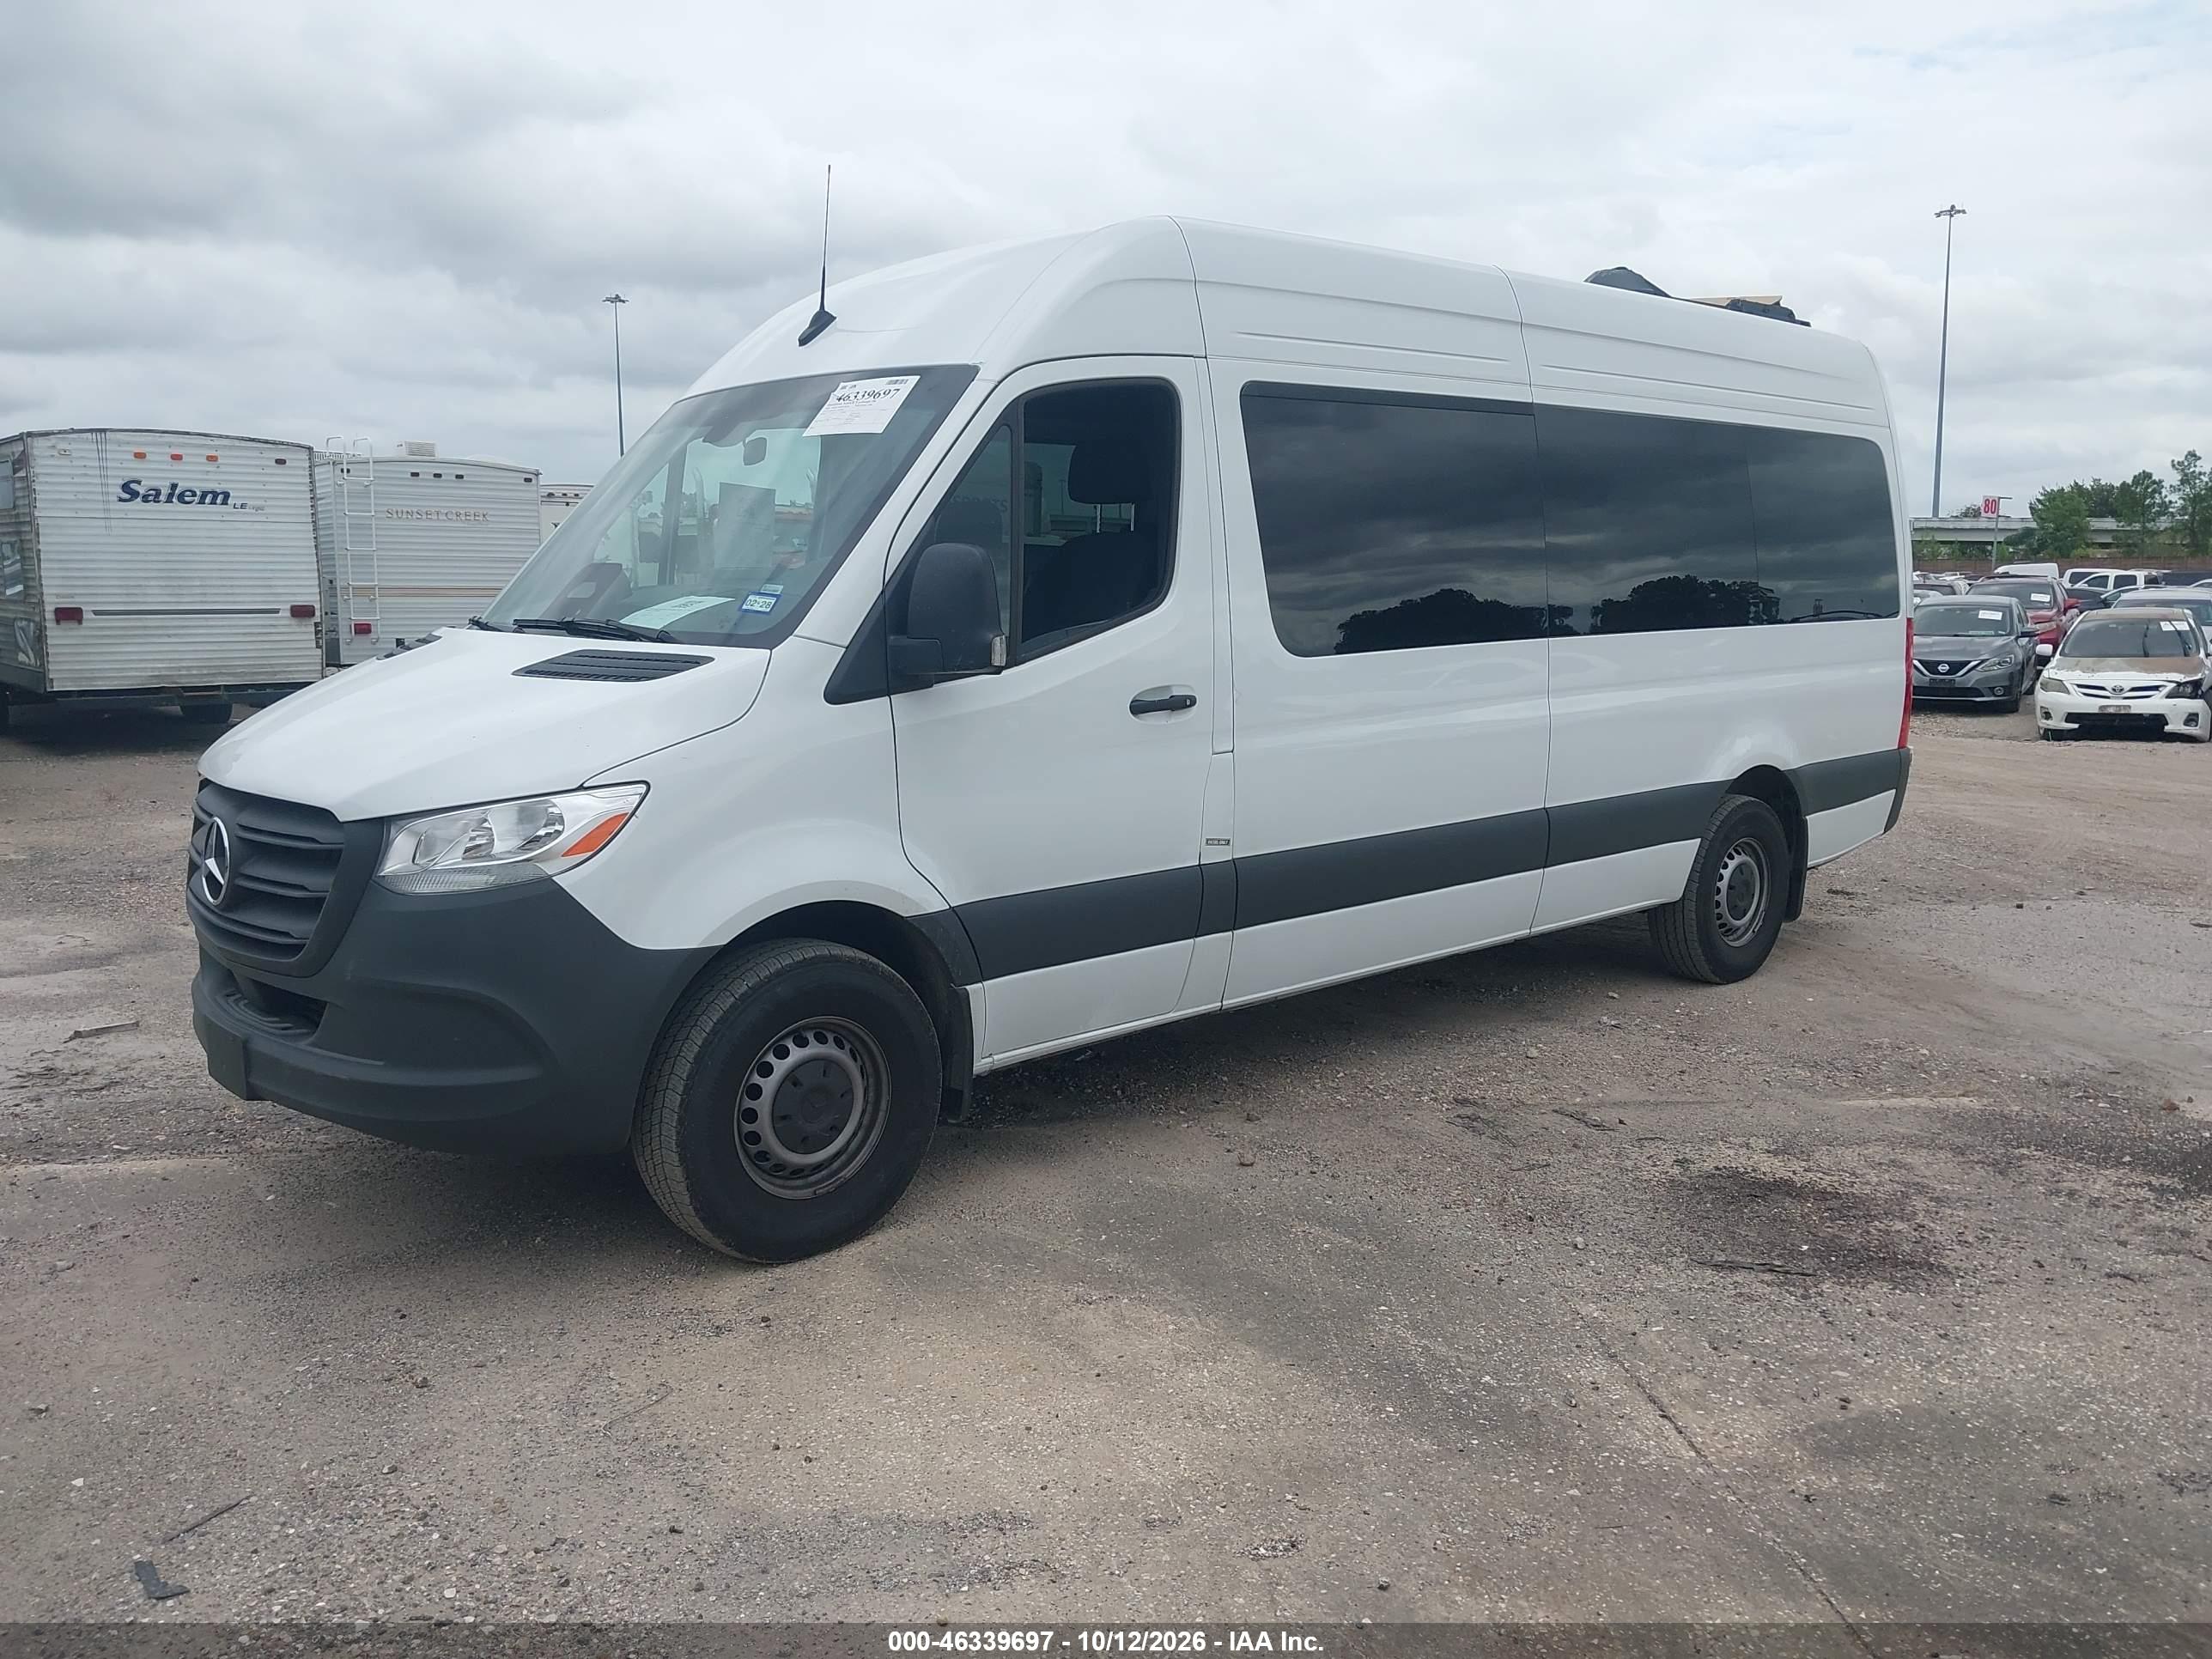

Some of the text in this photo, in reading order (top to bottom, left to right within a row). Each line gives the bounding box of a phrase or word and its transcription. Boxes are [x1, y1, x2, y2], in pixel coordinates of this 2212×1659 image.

[836, 388, 901, 403] 46339697
[117, 478, 232, 506] Salem
[1984, 498, 1996, 514] 80
[386, 508, 489, 522] SUNSET CREEK
